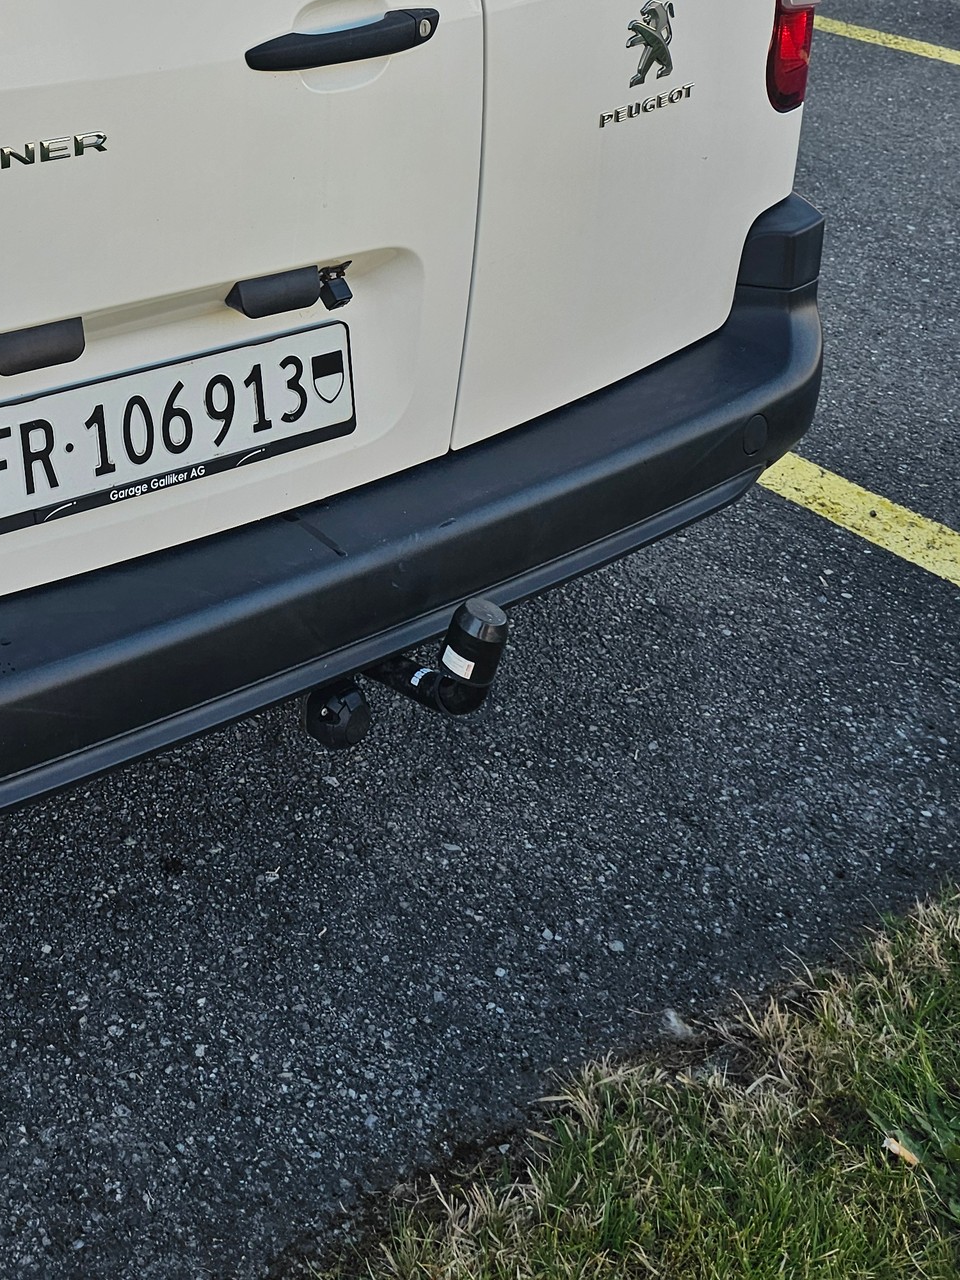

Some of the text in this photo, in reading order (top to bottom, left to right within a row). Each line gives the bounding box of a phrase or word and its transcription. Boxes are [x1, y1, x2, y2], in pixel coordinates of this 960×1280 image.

[599, 82, 695, 128] PEUGEOT
[110, 465, 206, 501] Garage Galliker AG
